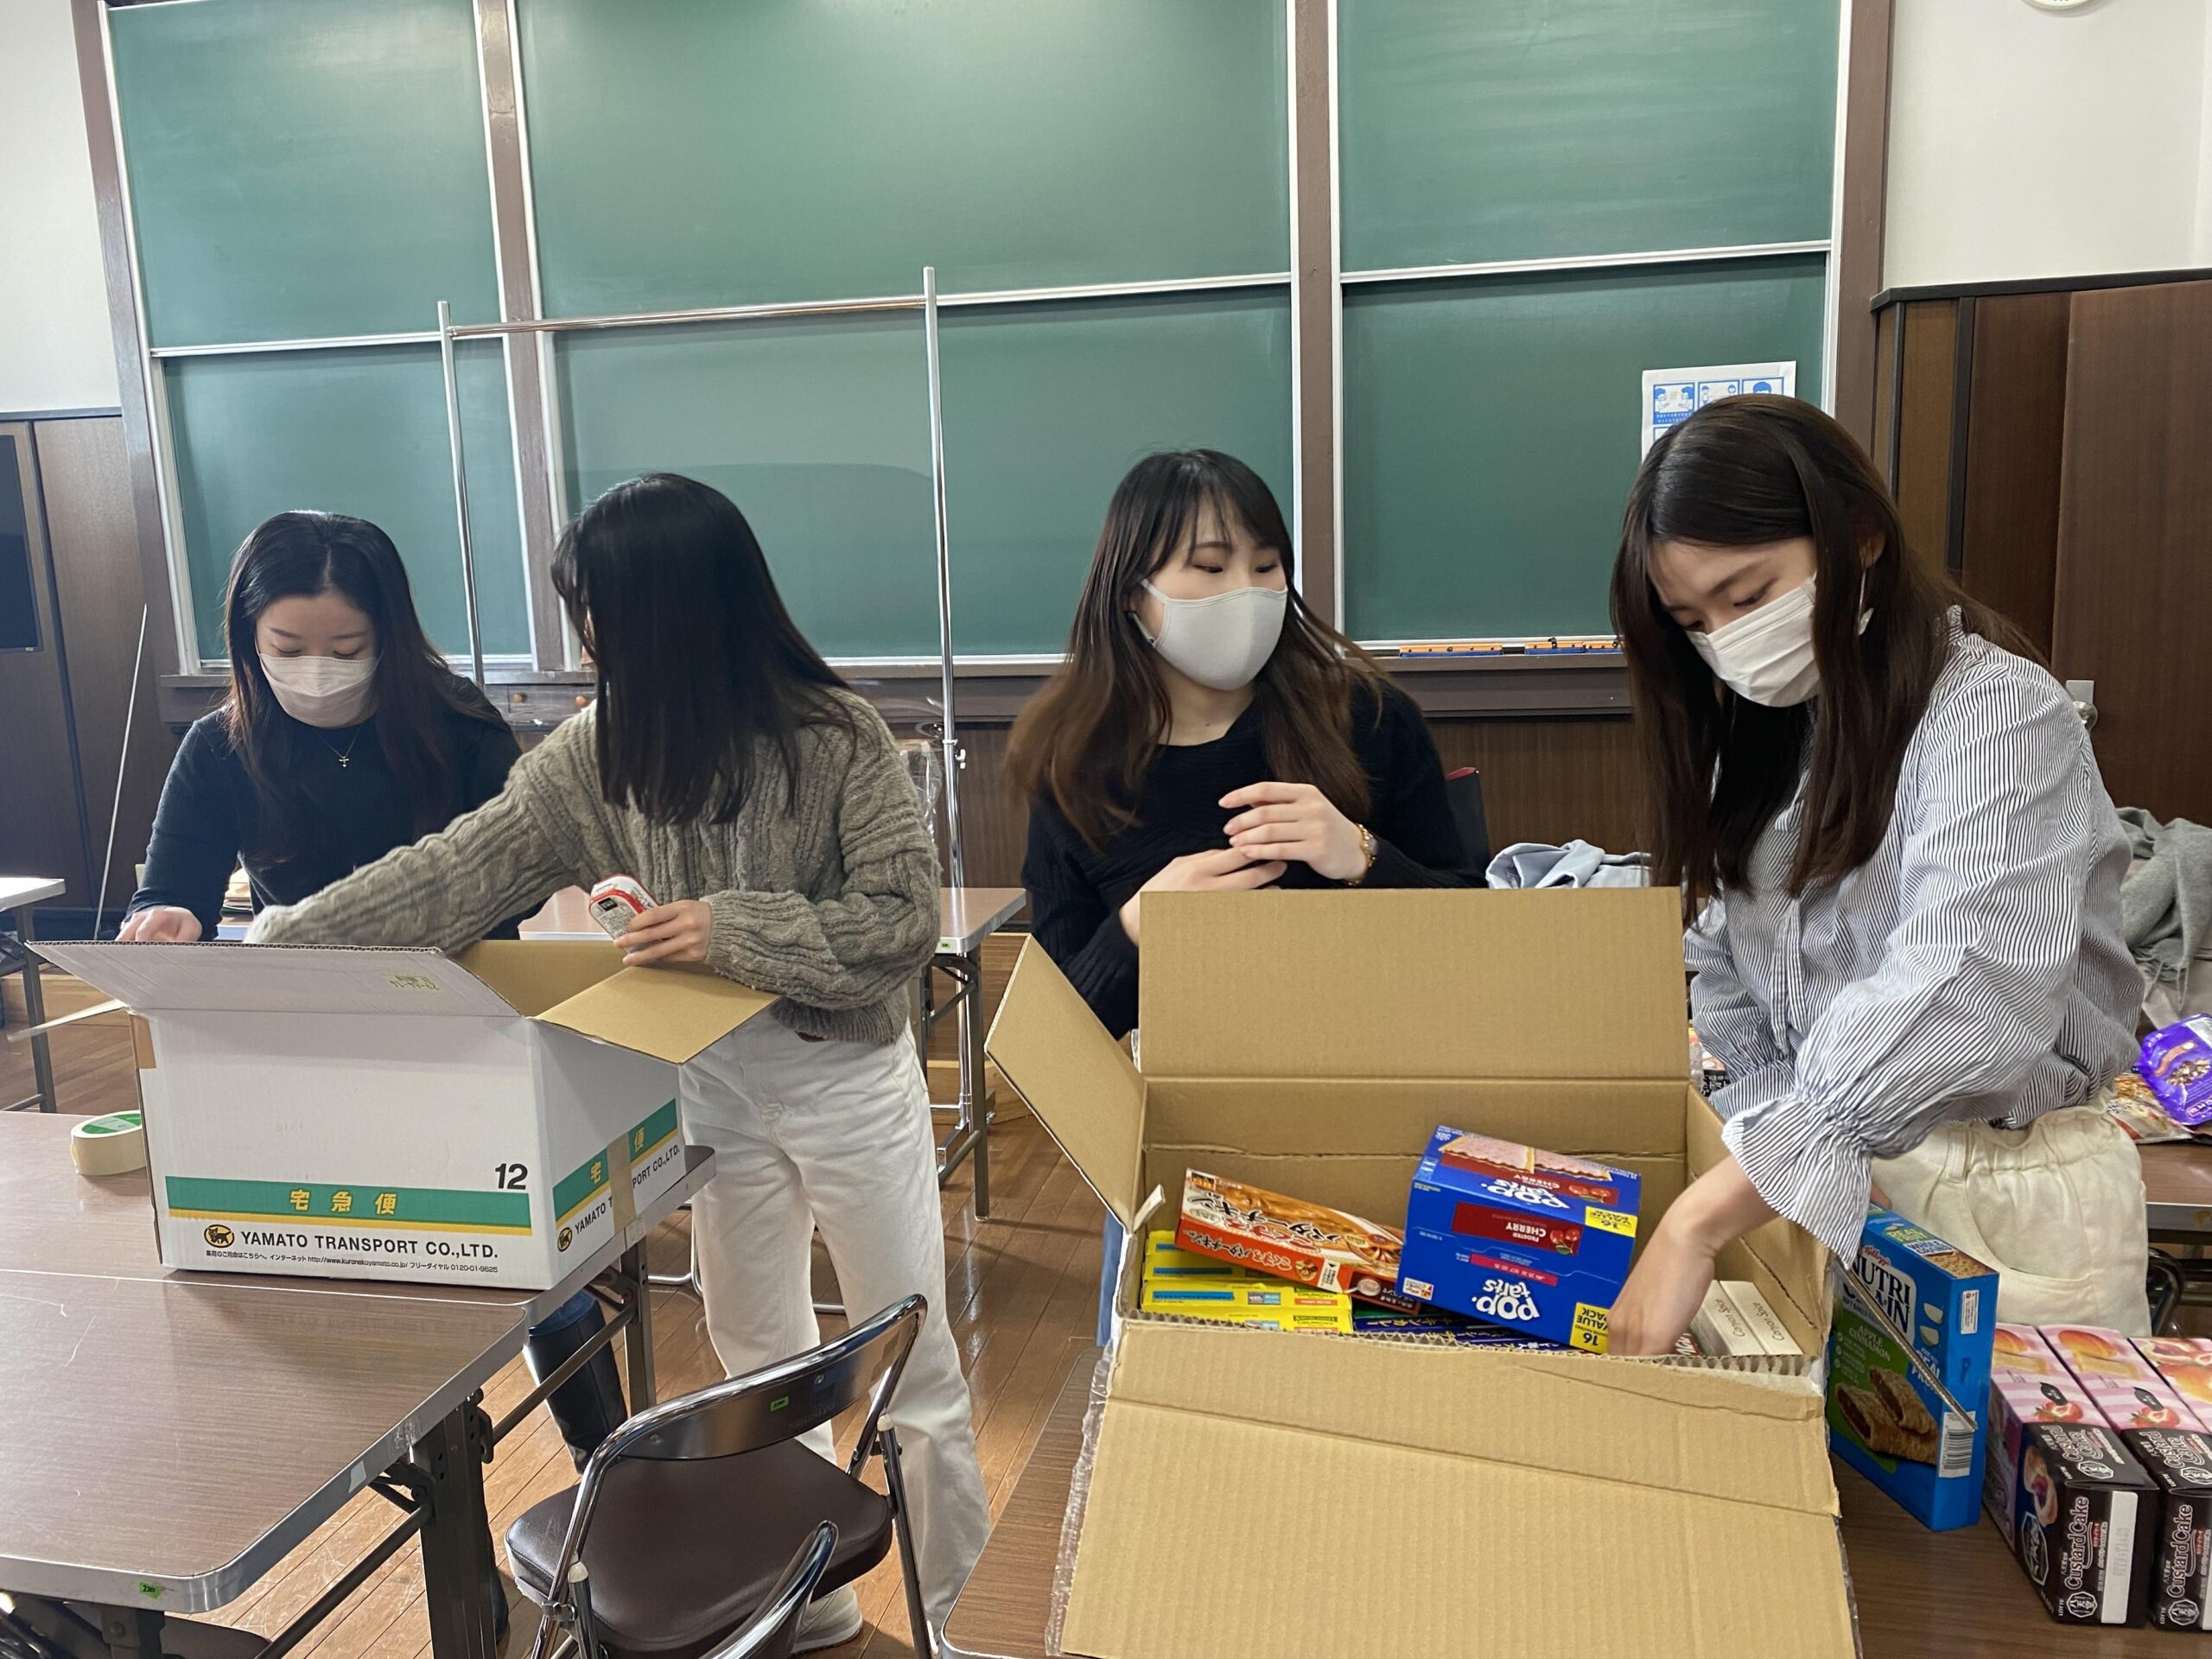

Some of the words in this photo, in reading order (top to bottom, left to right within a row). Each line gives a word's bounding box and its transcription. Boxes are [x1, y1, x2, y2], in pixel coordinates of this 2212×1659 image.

[494, 1163, 528, 1190] 12
[289, 1189, 397, 1216] 宅急便
[575, 1203, 607, 1235] YAMATO
[1505, 1222, 1547, 1237] CHERRY
[240, 1230, 308, 1248] YAMATO
[315, 1235, 418, 1254] TRANSPORT
[425, 1241, 499, 1258] CO.,LTD.
[1512, 1232, 1540, 1243] FROSTED
[1583, 1332, 1599, 1347] 16
[1859, 1325, 1883, 1344] APPLE
